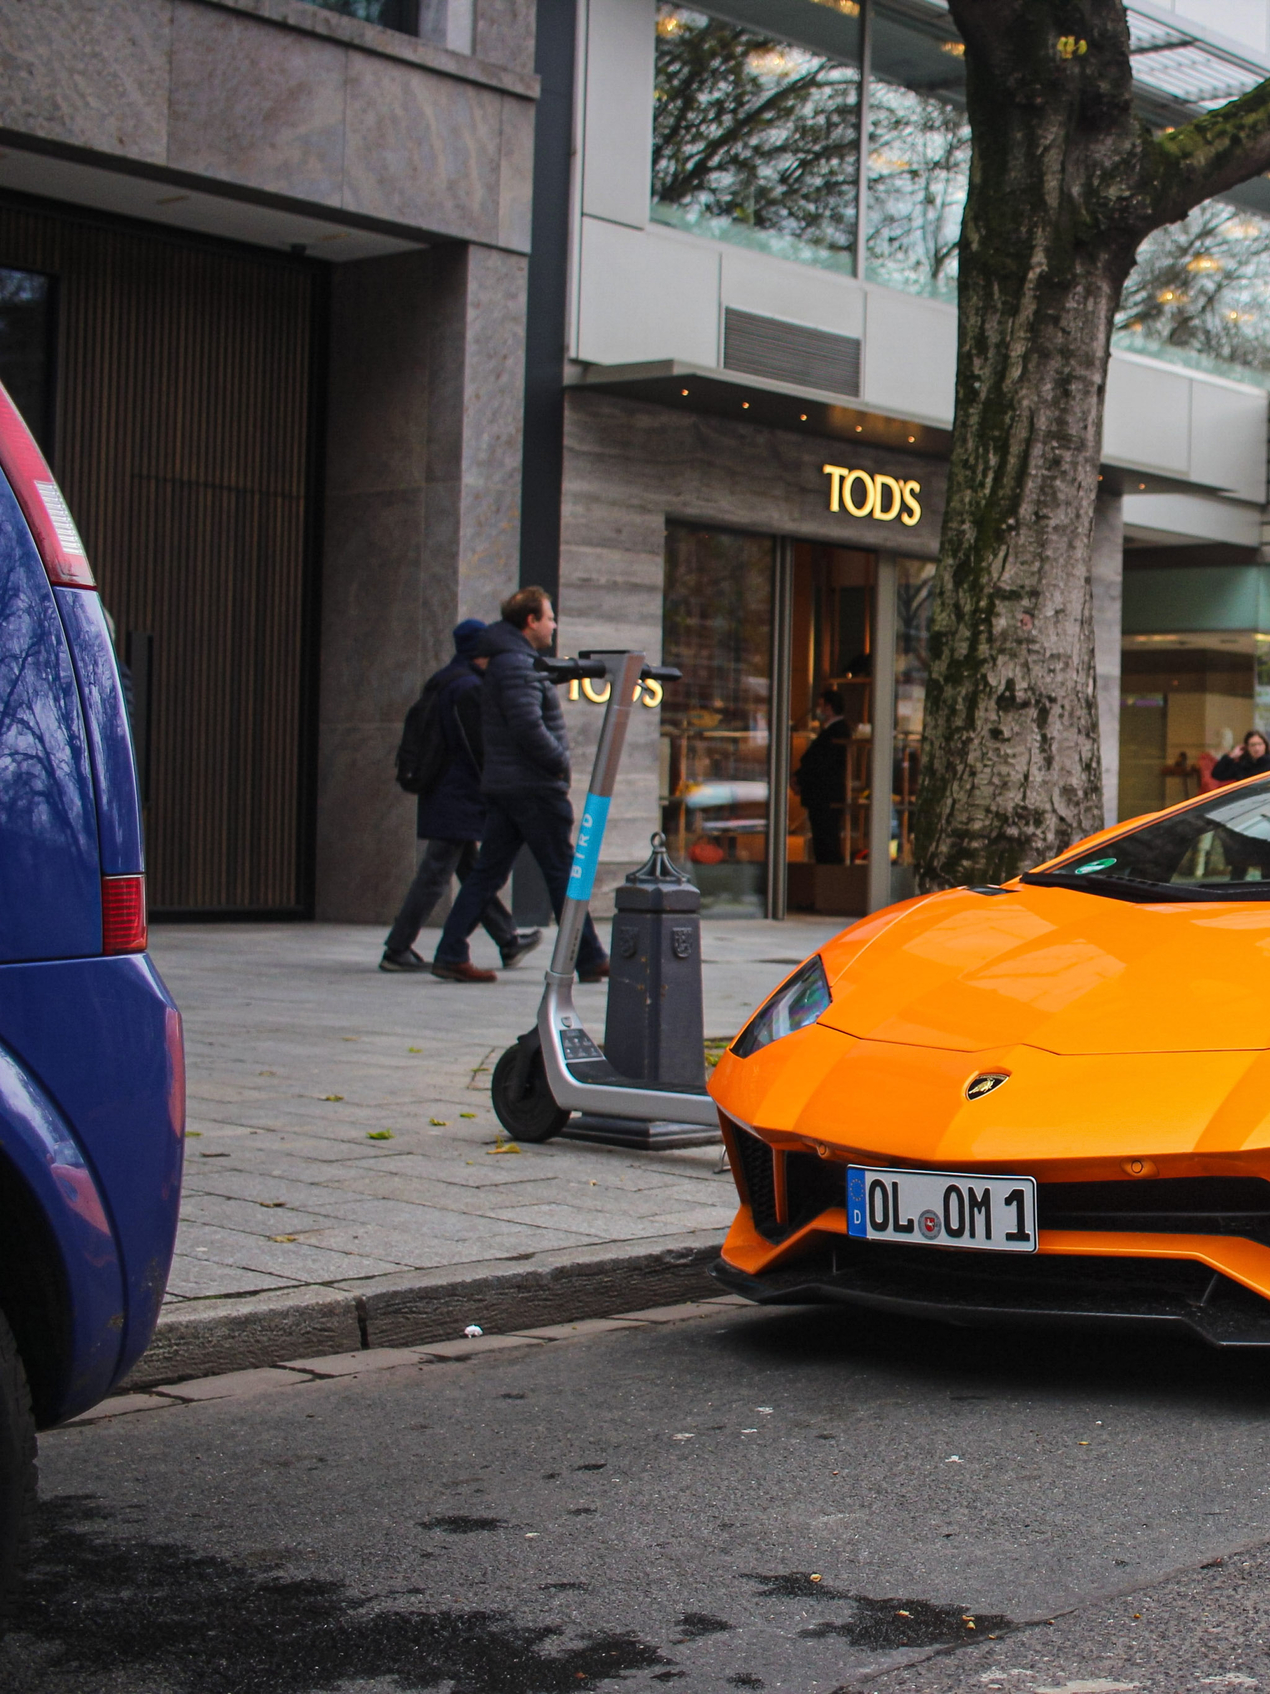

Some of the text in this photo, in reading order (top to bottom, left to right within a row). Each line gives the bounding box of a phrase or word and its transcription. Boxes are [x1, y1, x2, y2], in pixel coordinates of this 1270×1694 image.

[823, 464, 922, 526] TOD'S
[570, 813, 593, 879] BIRD
[853, 1209, 862, 1225] D
[868, 1178, 915, 1234] OL
[943, 1184, 992, 1240] OM
[1004, 1188, 1031, 1242] 1
